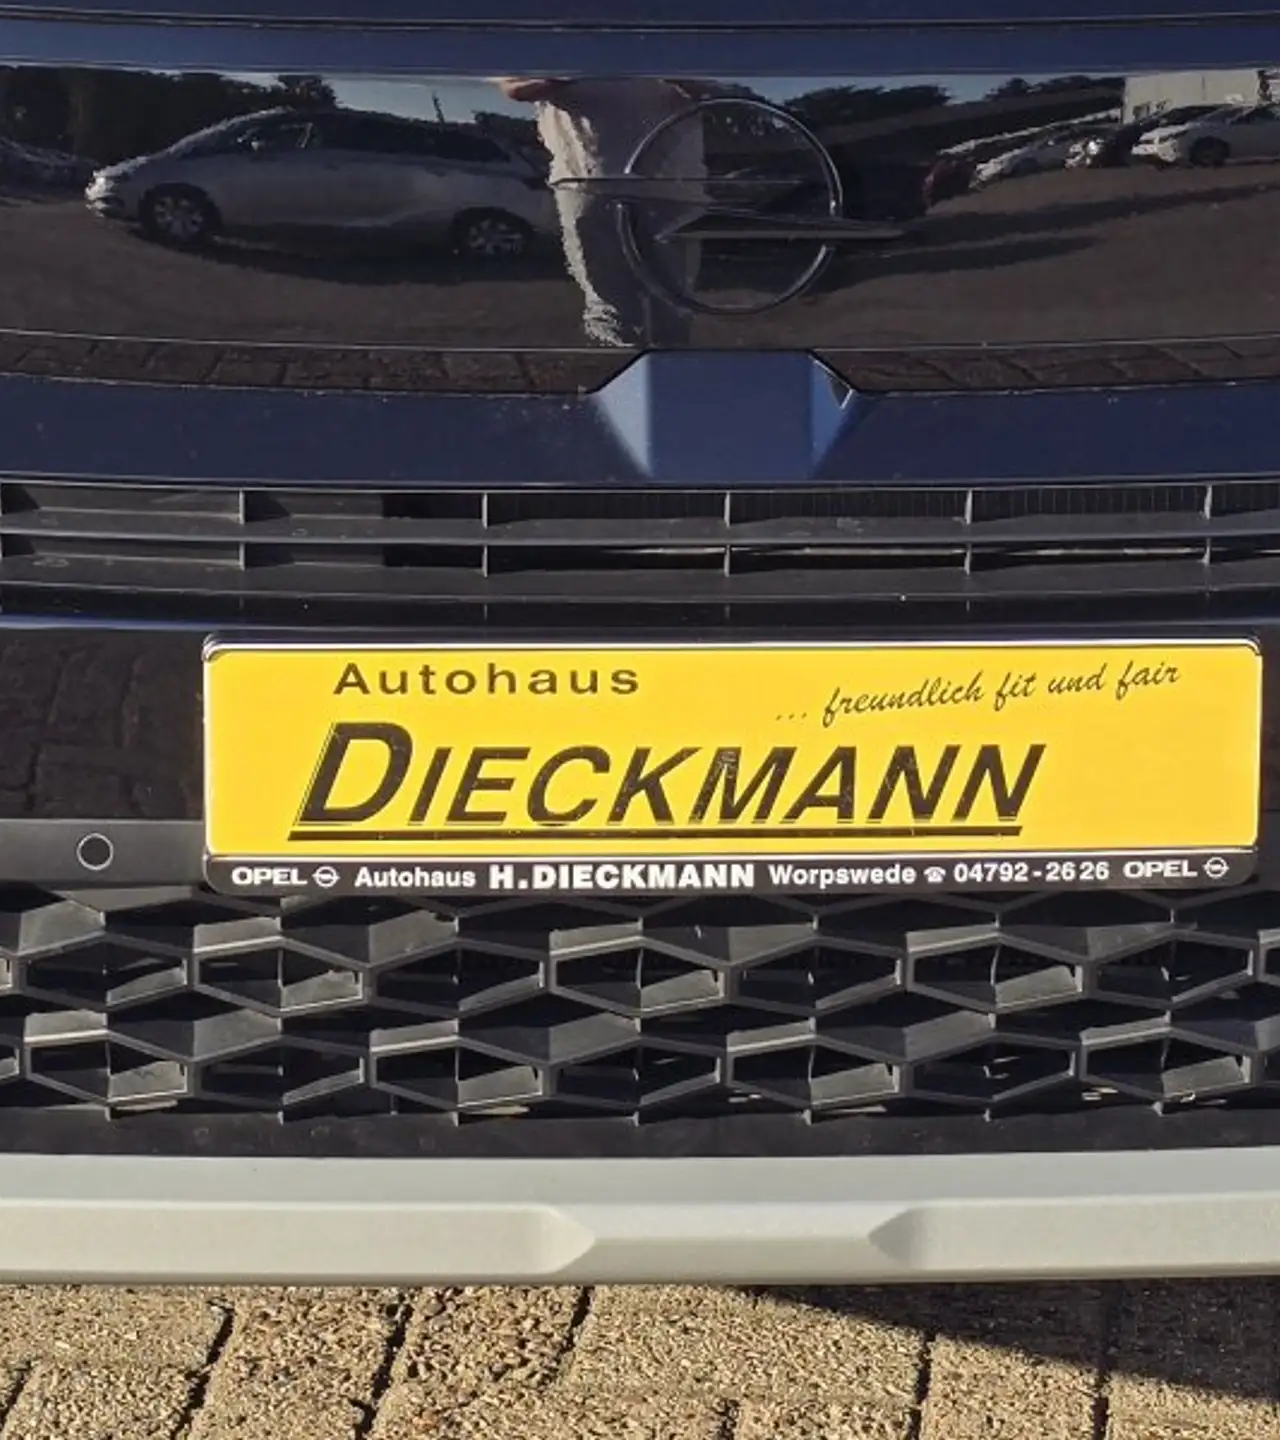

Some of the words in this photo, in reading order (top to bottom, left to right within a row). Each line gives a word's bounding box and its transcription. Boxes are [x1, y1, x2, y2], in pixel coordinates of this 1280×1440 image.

[332, 662, 640, 696] Autohaus
[821, 668, 985, 728] freundlich
[993, 670, 1037, 713] fit
[1046, 661, 1108, 697] und
[1114, 658, 1182, 702] fair
[292, 720, 1047, 828] DIECKMANN
[231, 866, 308, 886] OPEL
[354, 865, 477, 888] Autohaus
[488, 862, 756, 890] H.DIECKMANN
[767, 862, 918, 890] Worpswede
[1122, 859, 1199, 879] OPEL
